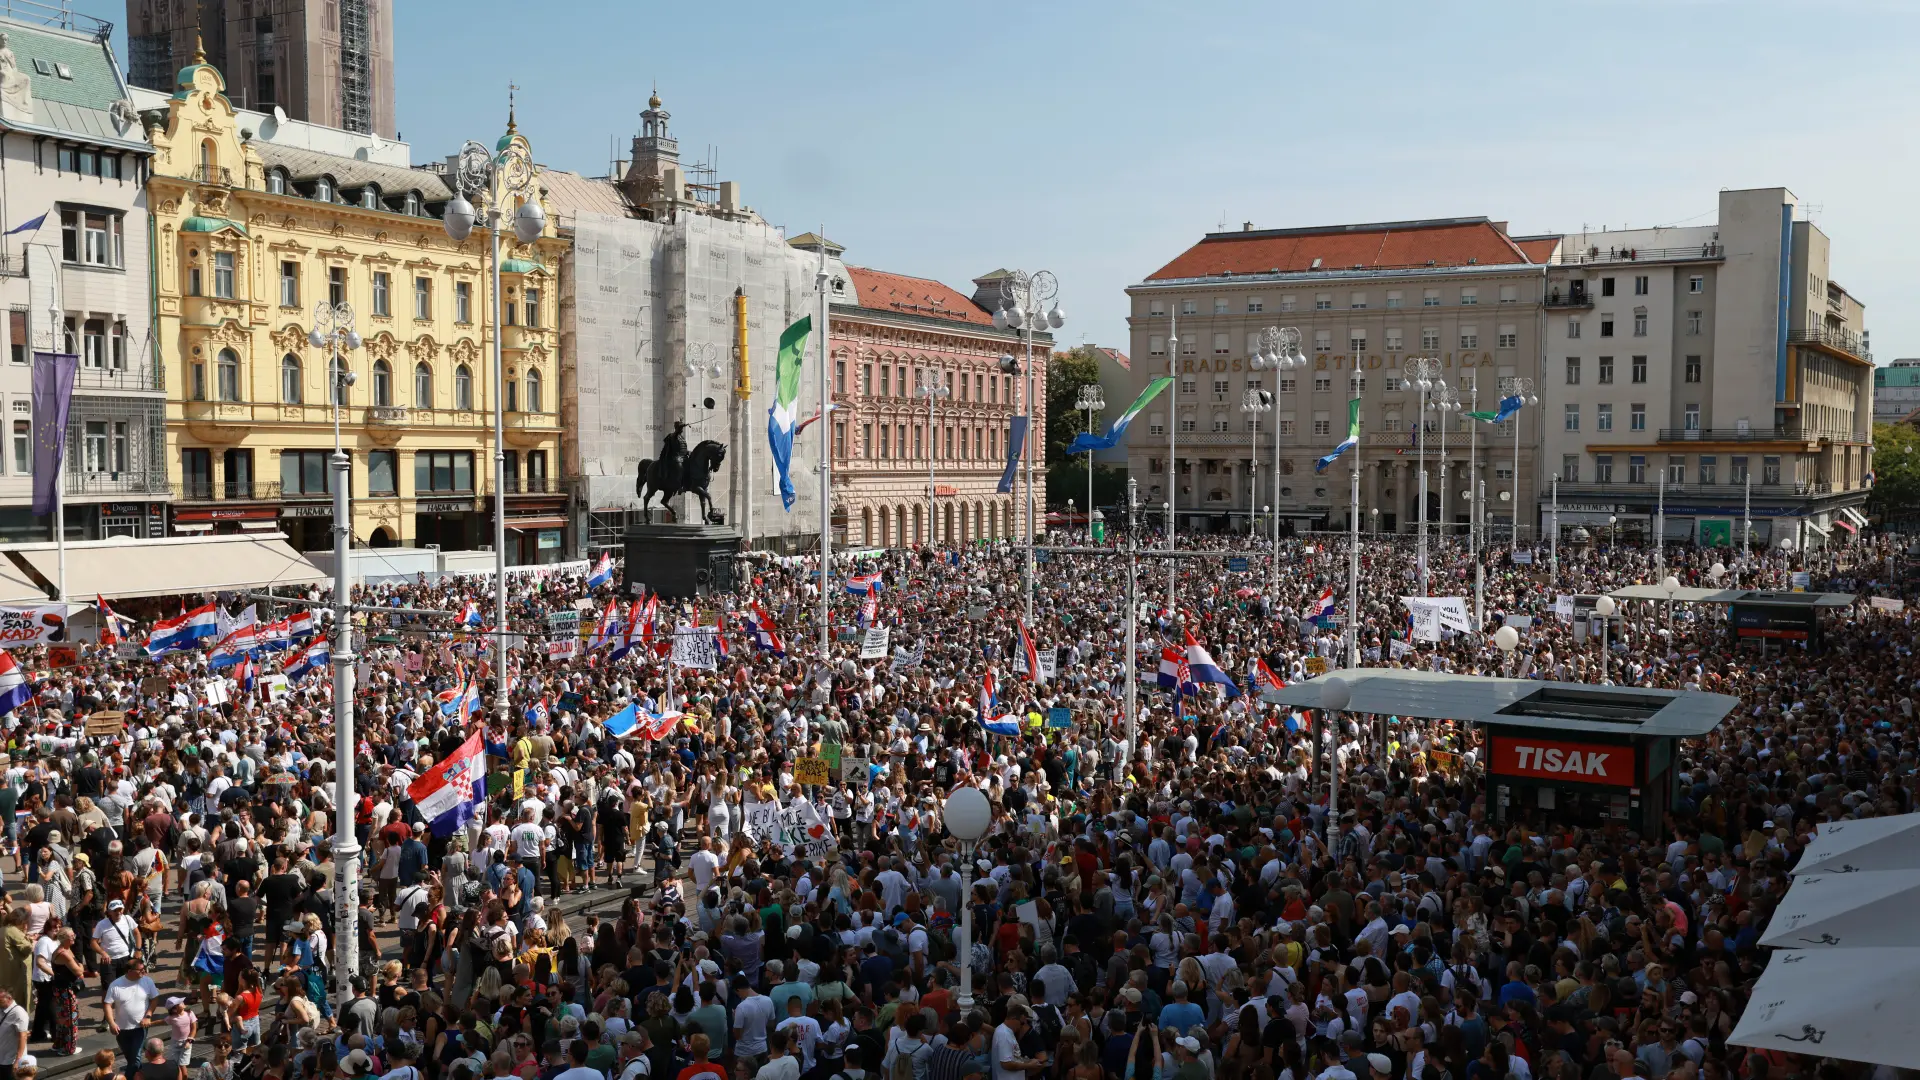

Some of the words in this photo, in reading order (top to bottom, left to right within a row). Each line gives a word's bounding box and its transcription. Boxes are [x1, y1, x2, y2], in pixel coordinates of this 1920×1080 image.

[936, 484, 960, 495] Müller
[112, 504, 138, 513] Dogma
[296, 507, 334, 516] HARMICA
[427, 503, 460, 512] HARMICA
[1, 612, 20, 620] AKO
[21, 610, 36, 620] NE
[3, 620, 35, 630] SAD,
[0, 626, 44, 641] KAD?
[1514, 746, 1610, 777] TISAK
